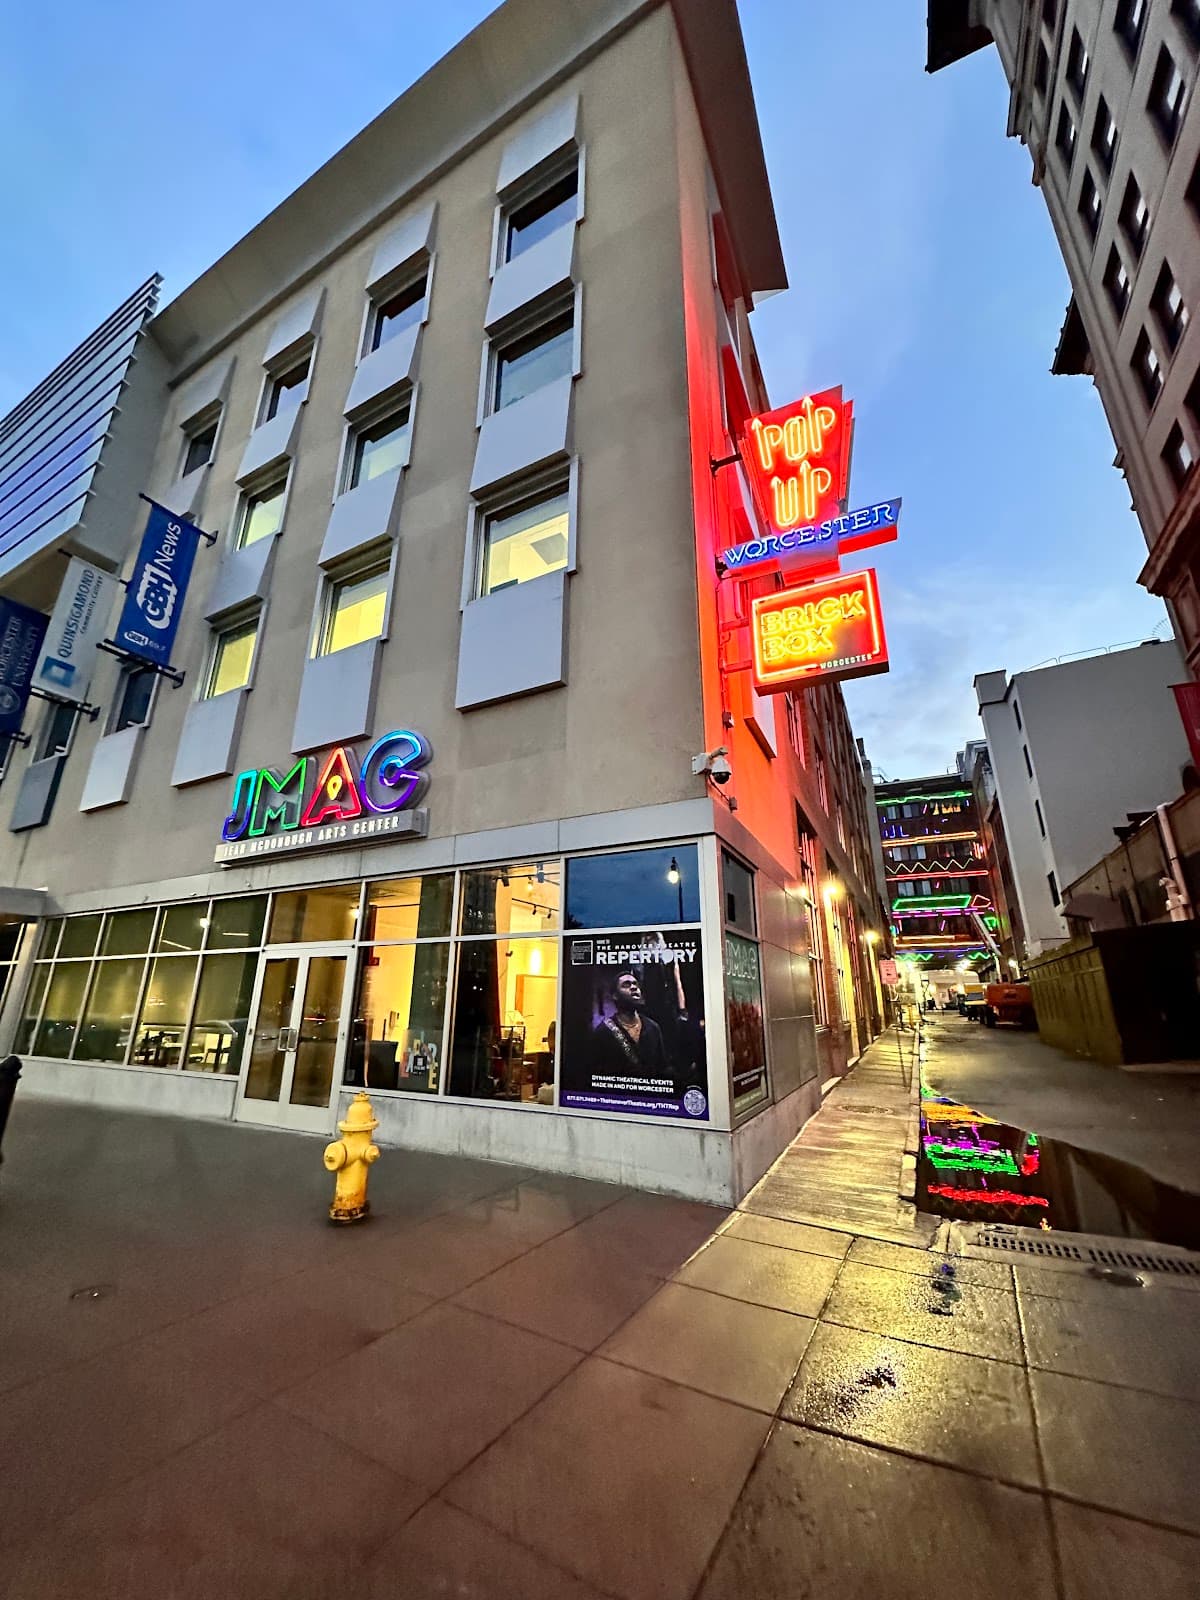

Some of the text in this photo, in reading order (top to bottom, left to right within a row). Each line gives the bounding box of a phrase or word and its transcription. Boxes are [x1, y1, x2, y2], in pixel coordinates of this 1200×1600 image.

[751, 395, 836, 469] POP
[771, 460, 832, 528] UP
[155, 521, 182, 570] News
[724, 503, 895, 565] WORCESTER
[58, 569, 96, 659] QUINSIGAMOND
[761, 589, 867, 637] BRICK
[762, 624, 833, 662] BOX
[819, 653, 873, 670] WORCESTER
[222, 729, 430, 842] JMAC
[318, 825, 347, 842] ARTS
[353, 816, 400, 836] CENTER
[595, 948, 697, 965] REPERTORY
